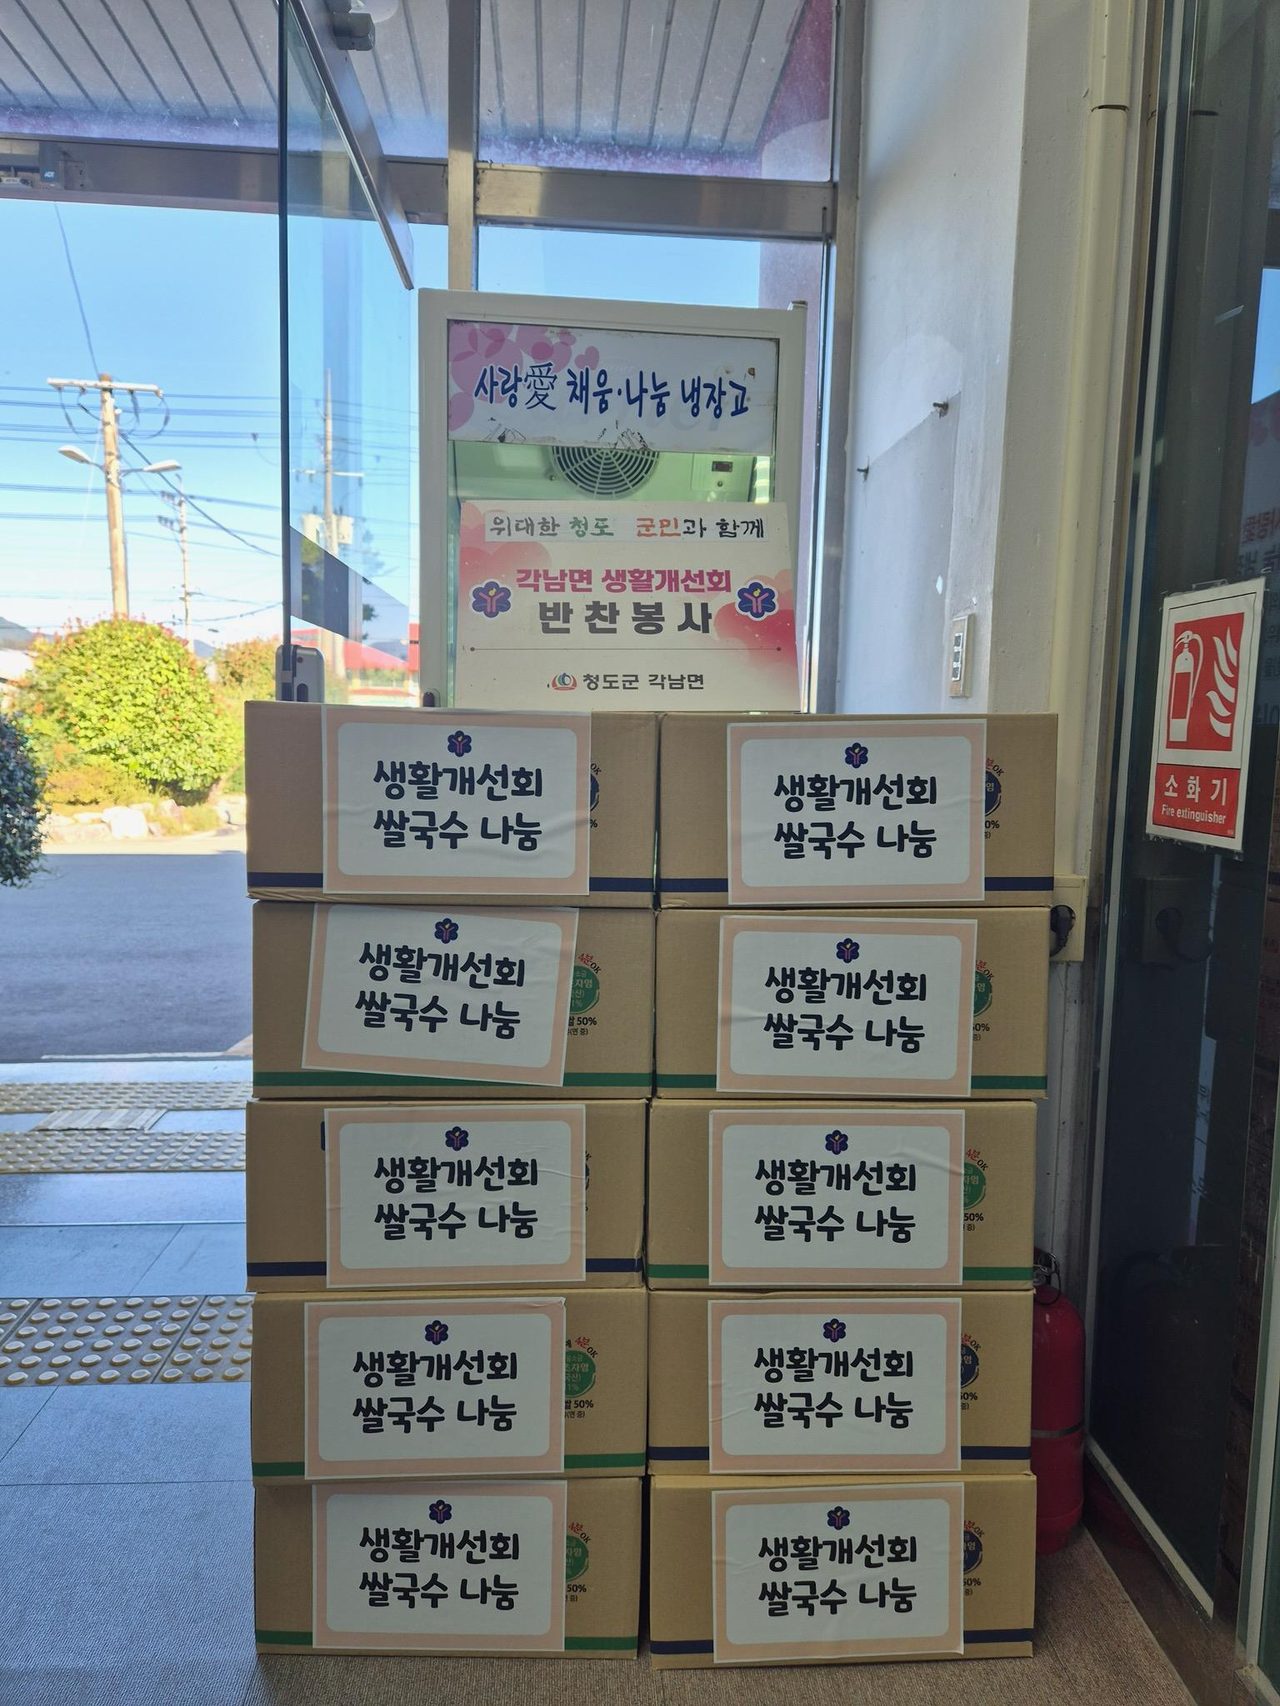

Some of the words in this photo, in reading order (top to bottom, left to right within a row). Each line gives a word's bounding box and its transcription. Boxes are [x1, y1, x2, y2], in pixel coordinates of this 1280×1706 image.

[474, 362, 557, 411] 사랑愛
[681, 376, 749, 419] 냉장고
[490, 516, 560, 536] 위대한
[569, 516, 614, 538] 청도
[636, 517, 706, 538] 군민과
[716, 518, 764, 538] 함께
[515, 568, 593, 593] 각남면
[601, 568, 732, 594] 생활개선회
[582, 673, 640, 691] 청도군
[648, 674, 704, 690] 각남면
[373, 761, 542, 801] 생활개선회
[774, 774, 936, 812] 생활개선회
[373, 810, 468, 849] 쌀국수
[481, 813, 542, 851] 나눔
[1161, 803, 1175, 817] Fire
[1176, 807, 1226, 825] extinguisher
[774, 821, 865, 859] 쌀국수
[877, 821, 937, 858] 나눔
[359, 942, 524, 989] 생활개선회
[765, 967, 926, 1005] 생활개선회
[355, 991, 448, 1033] 쌀국수
[460, 1001, 520, 1039] 나눔
[577, 1017, 597, 1026] 50%
[764, 1013, 853, 1050] 쌀국수
[866, 1016, 925, 1053] 나눔
[374, 1156, 537, 1194] 생활개선회
[755, 1159, 916, 1196] 생활개선회
[374, 1202, 466, 1240] 쌀국수
[479, 1201, 538, 1238] 나눔
[755, 1205, 844, 1242] 쌀국수
[857, 1206, 915, 1243] 나눔
[964, 1213, 984, 1221] 50%
[353, 1350, 517, 1388] 생활개선회
[754, 1347, 913, 1383] 생활개선회
[353, 1396, 445, 1433] 쌀국수
[457, 1395, 517, 1431] 나눔
[574, 1400, 594, 1409] 50%
[754, 1392, 843, 1429] 쌀국수
[855, 1392, 913, 1429] 나눔
[360, 1527, 519, 1564] 생활개선회
[759, 1534, 916, 1572] 생활개선회
[359, 1572, 448, 1608] 쌀국수
[460, 1575, 519, 1610] 나눔
[567, 1584, 587, 1592] 50%
[759, 1579, 847, 1616] 쌀국수
[859, 1578, 917, 1613] 나눔
